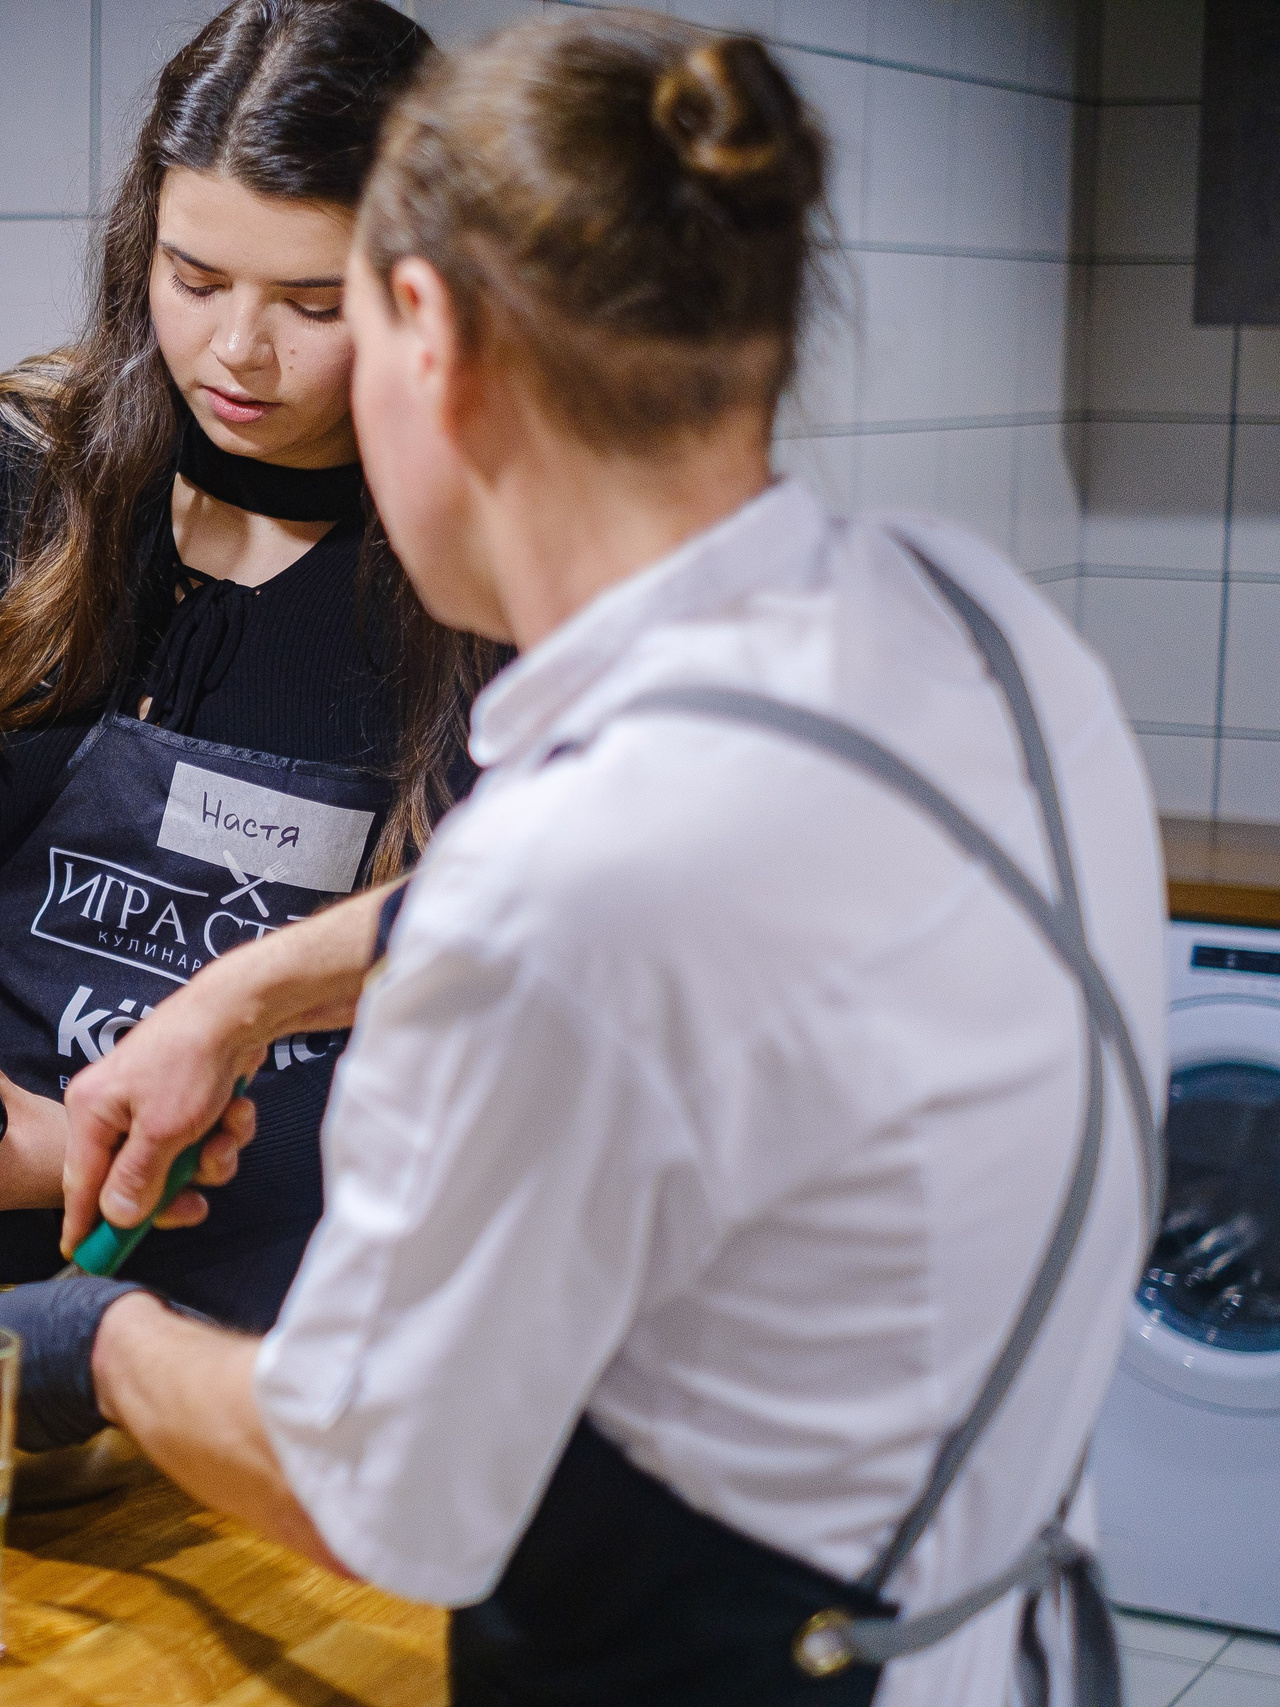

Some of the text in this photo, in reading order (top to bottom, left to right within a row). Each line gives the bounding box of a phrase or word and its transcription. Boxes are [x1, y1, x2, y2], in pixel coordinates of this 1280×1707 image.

[202, 791, 300, 849] Настя
[58, 861, 187, 946] ИГРА
[98, 930, 203, 973] КУЛИНАР
